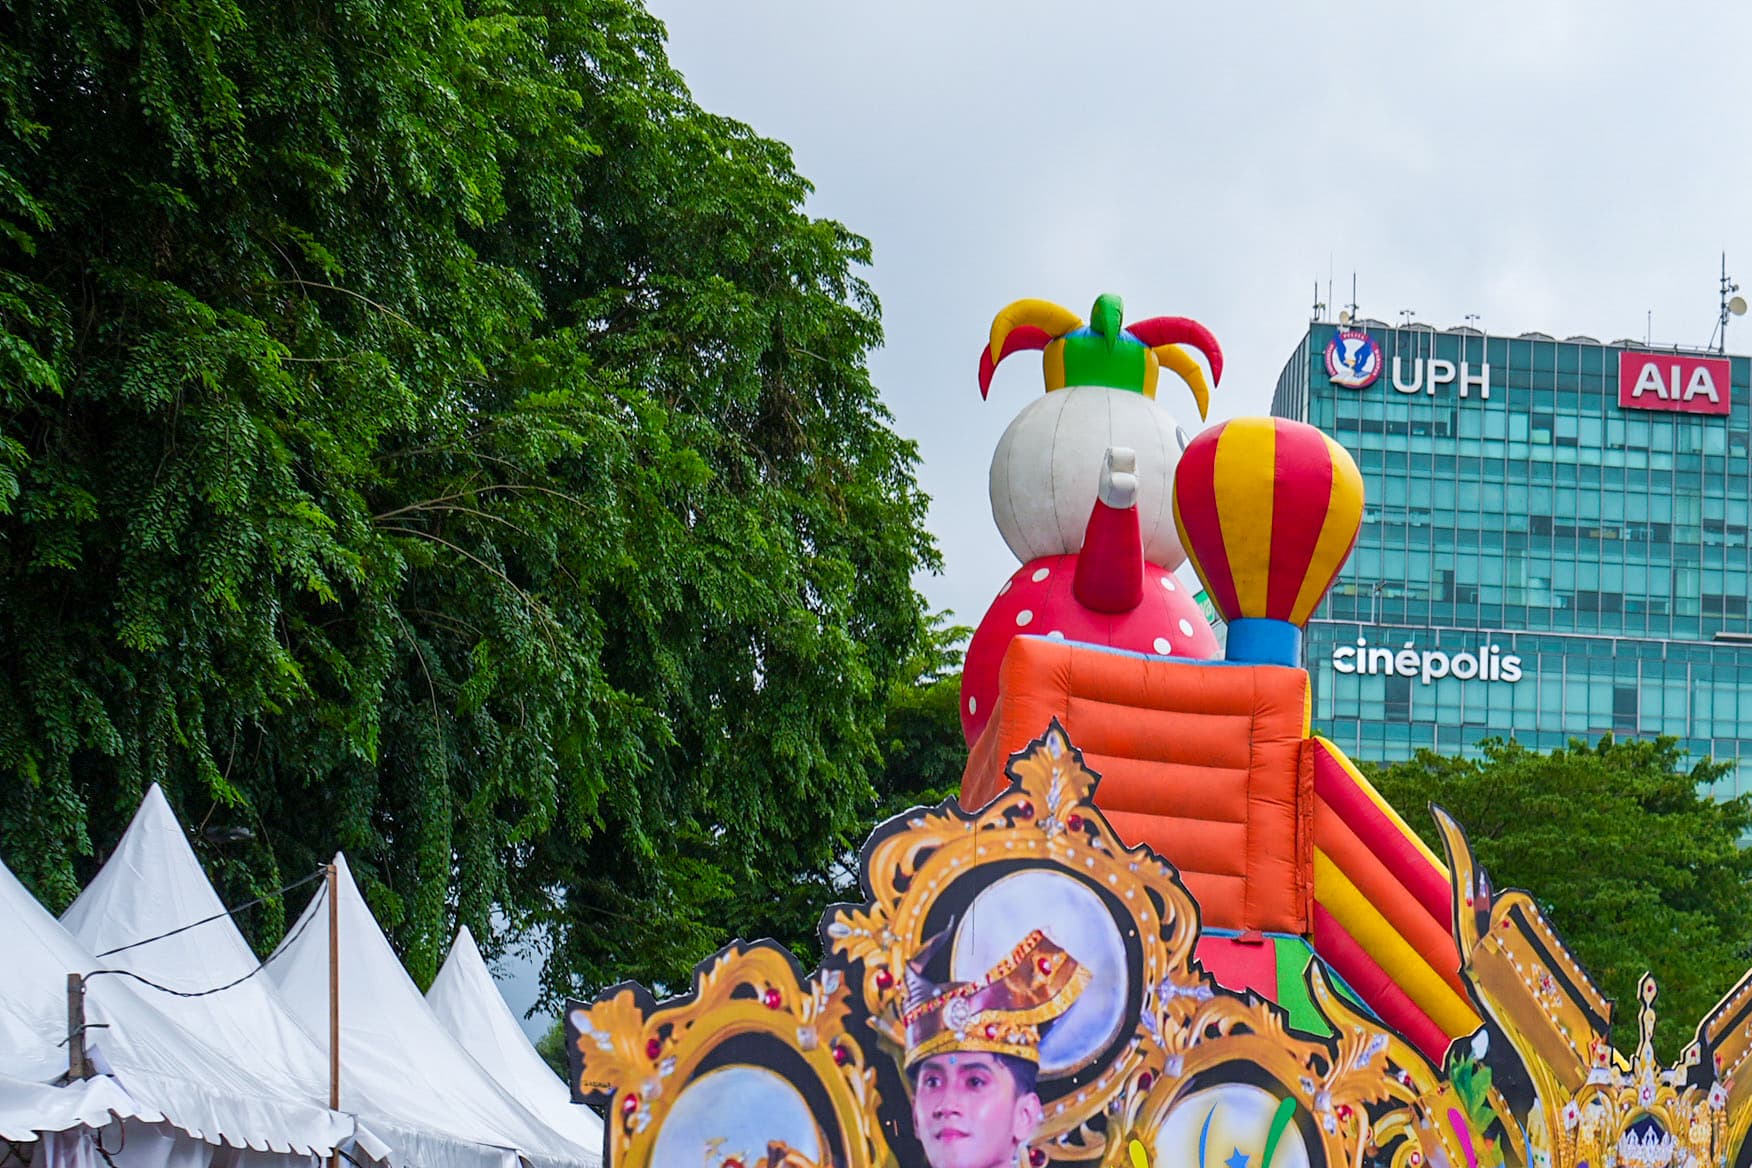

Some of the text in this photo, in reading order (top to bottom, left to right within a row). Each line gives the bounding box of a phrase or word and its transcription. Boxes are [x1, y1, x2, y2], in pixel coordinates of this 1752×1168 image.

[1391, 356, 1490, 399] UPH
[1632, 363, 1719, 403] AIA
[1332, 638, 1523, 683] cinépolis
